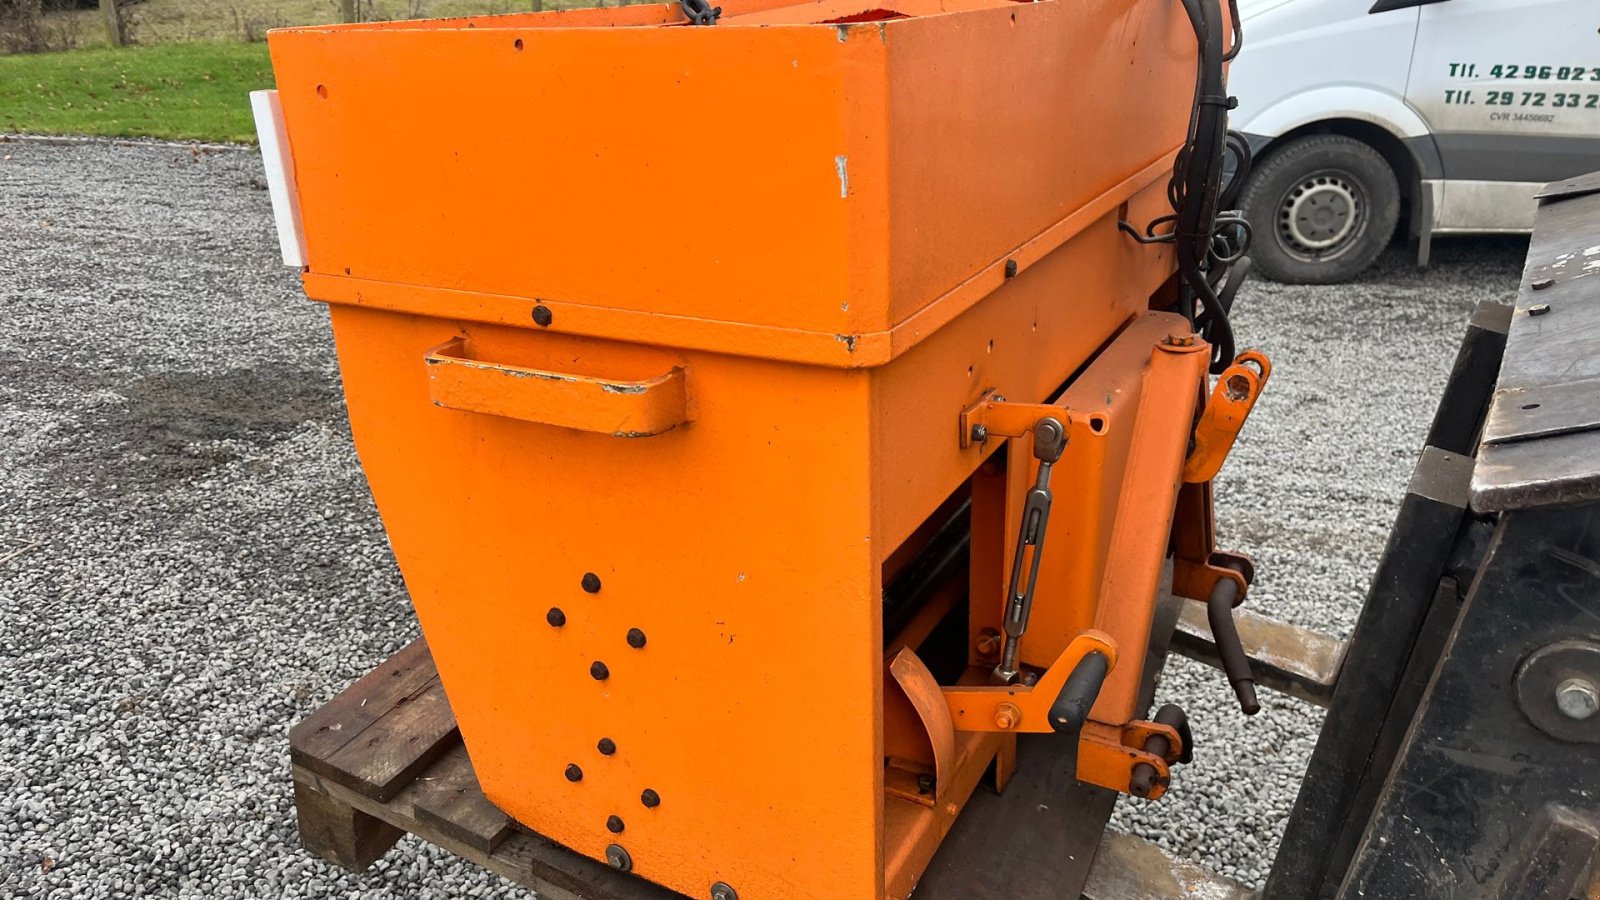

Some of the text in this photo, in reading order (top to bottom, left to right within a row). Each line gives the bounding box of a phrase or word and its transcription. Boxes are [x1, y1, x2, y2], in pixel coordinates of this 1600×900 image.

[1449, 63, 1479, 78] Tlf.
[1490, 64, 1519, 79] 42
[1523, 65, 1552, 80] 96
[1557, 66, 1586, 81] 02
[1445, 90, 1475, 105] Tlf.
[1485, 91, 1514, 105] 29
[1520, 92, 1546, 106] 72
[1552, 93, 1581, 107] 33
[1490, 112, 1510, 121] CVR
